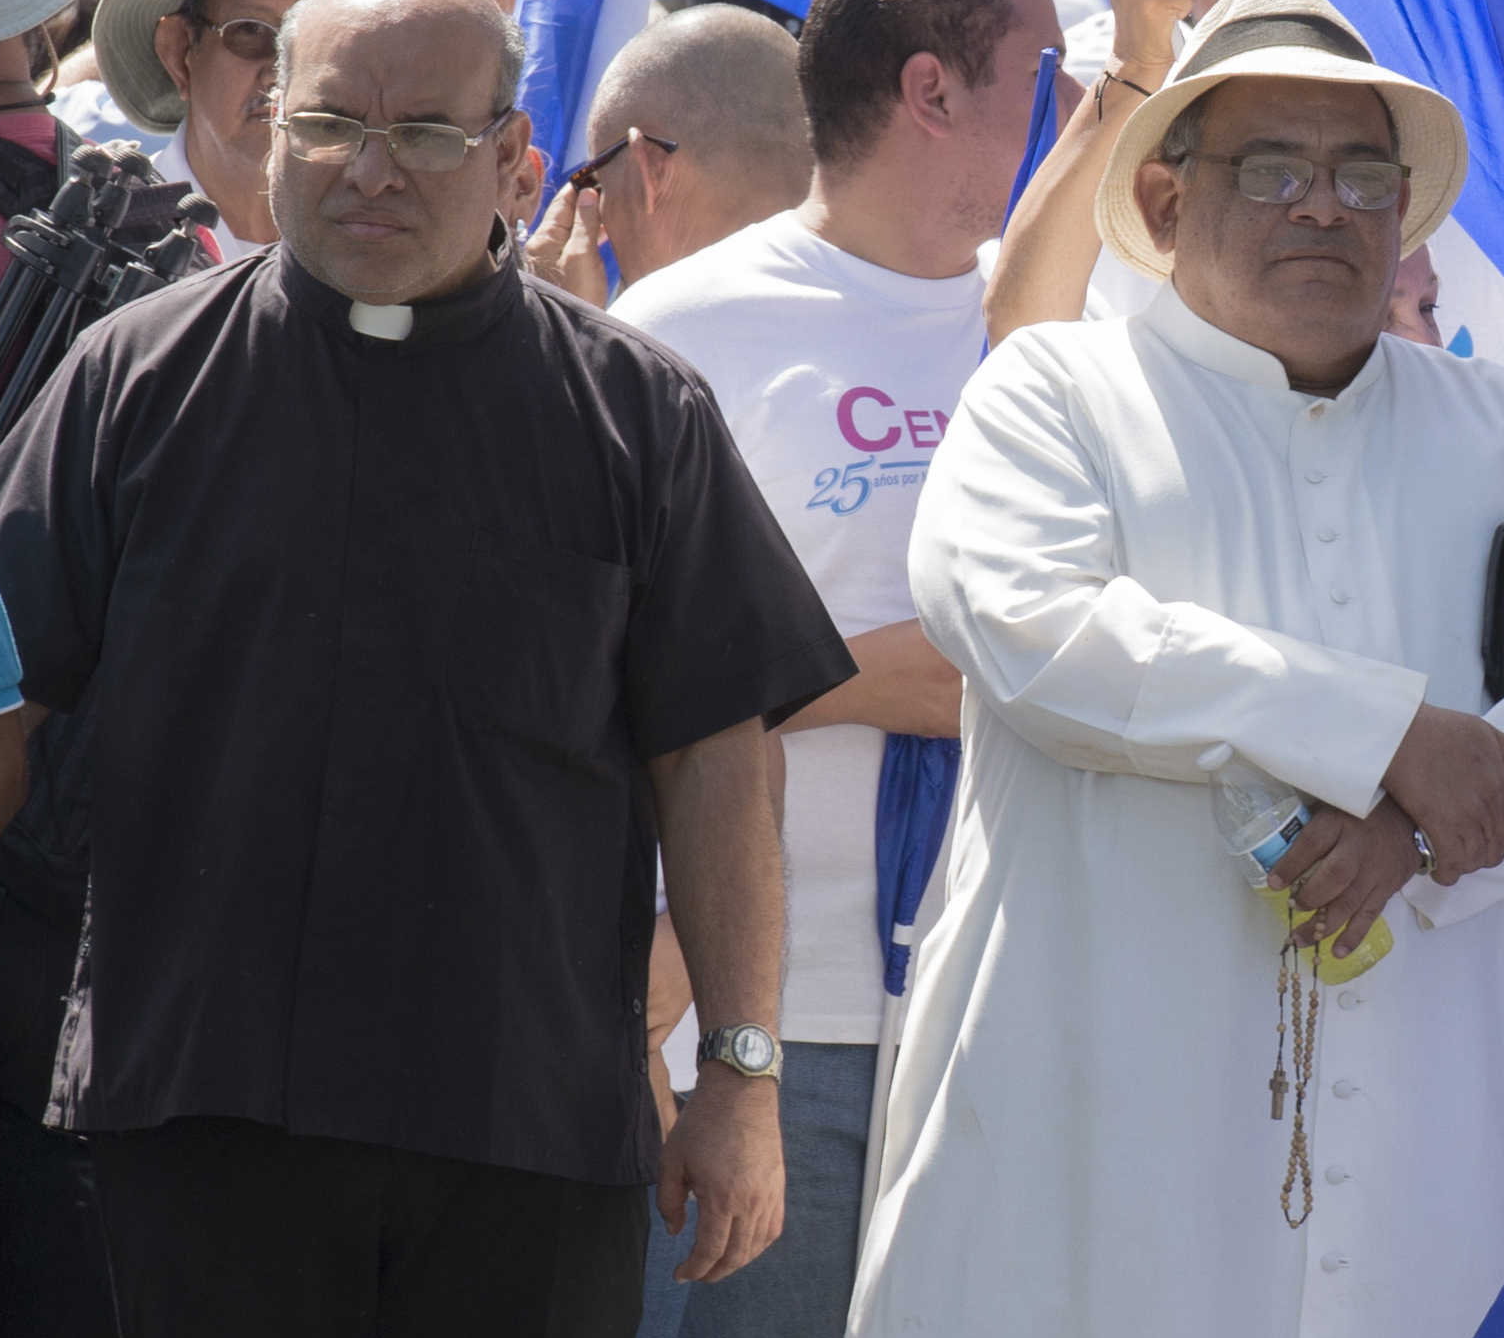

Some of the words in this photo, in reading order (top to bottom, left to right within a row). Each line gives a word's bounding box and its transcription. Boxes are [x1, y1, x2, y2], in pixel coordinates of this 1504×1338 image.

[805, 454, 877, 517] 25
[873, 471, 899, 488] años
[902, 472, 920, 487] por
